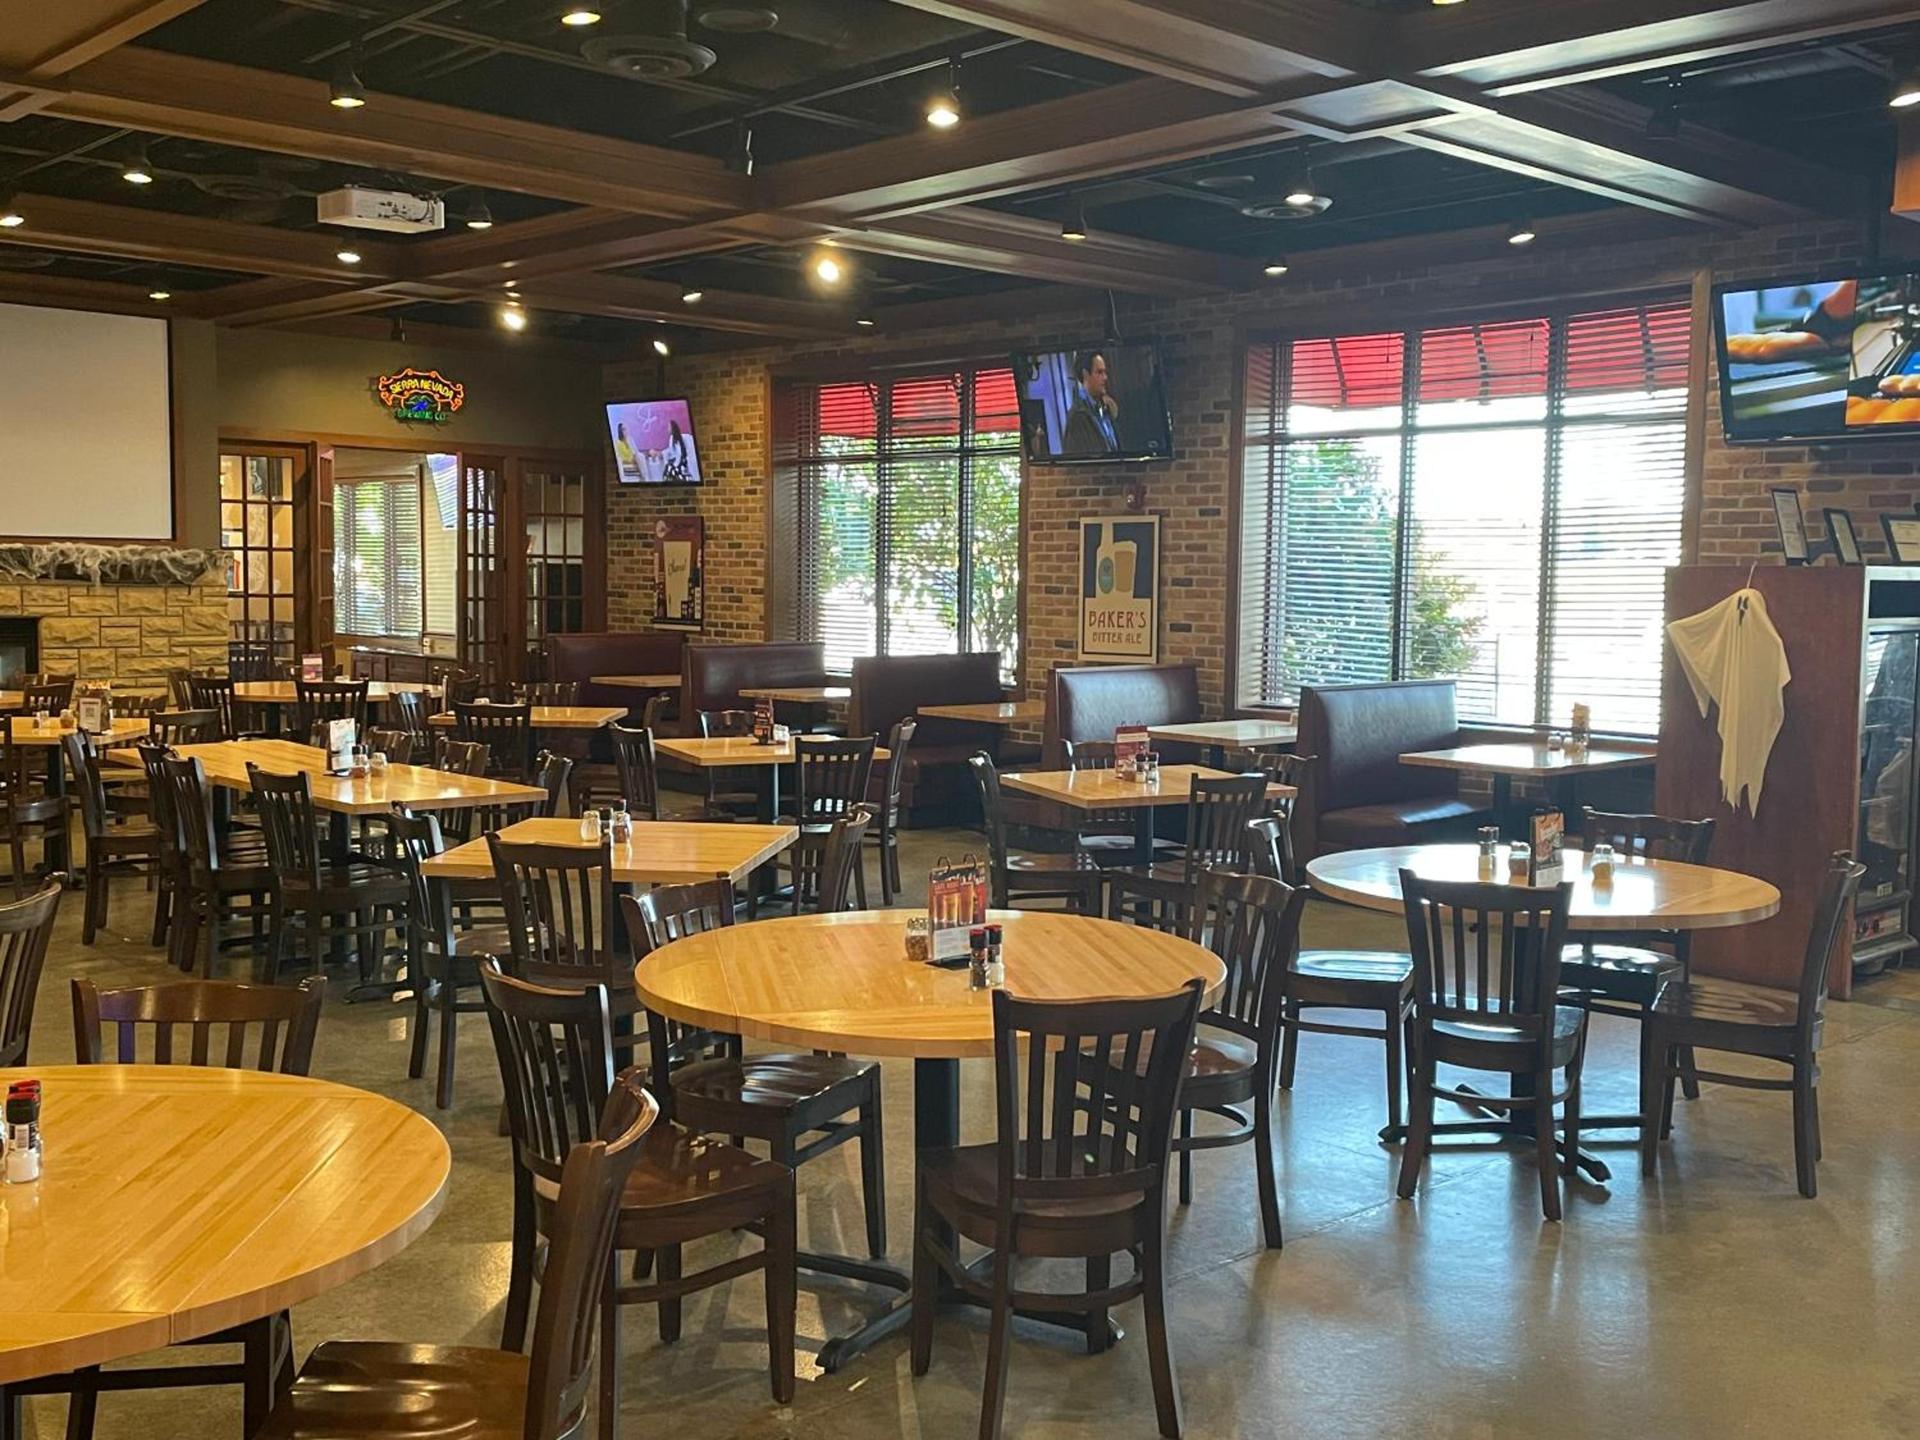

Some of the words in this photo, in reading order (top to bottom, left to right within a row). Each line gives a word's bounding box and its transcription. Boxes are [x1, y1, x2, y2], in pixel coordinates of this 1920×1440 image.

[390, 379, 419, 394] SIERRA
[420, 379, 454, 398] NEVADA
[1089, 611, 1147, 628] BAKER'S
[1092, 632, 1122, 644] BITTER
[1124, 633, 1142, 645] ALE
